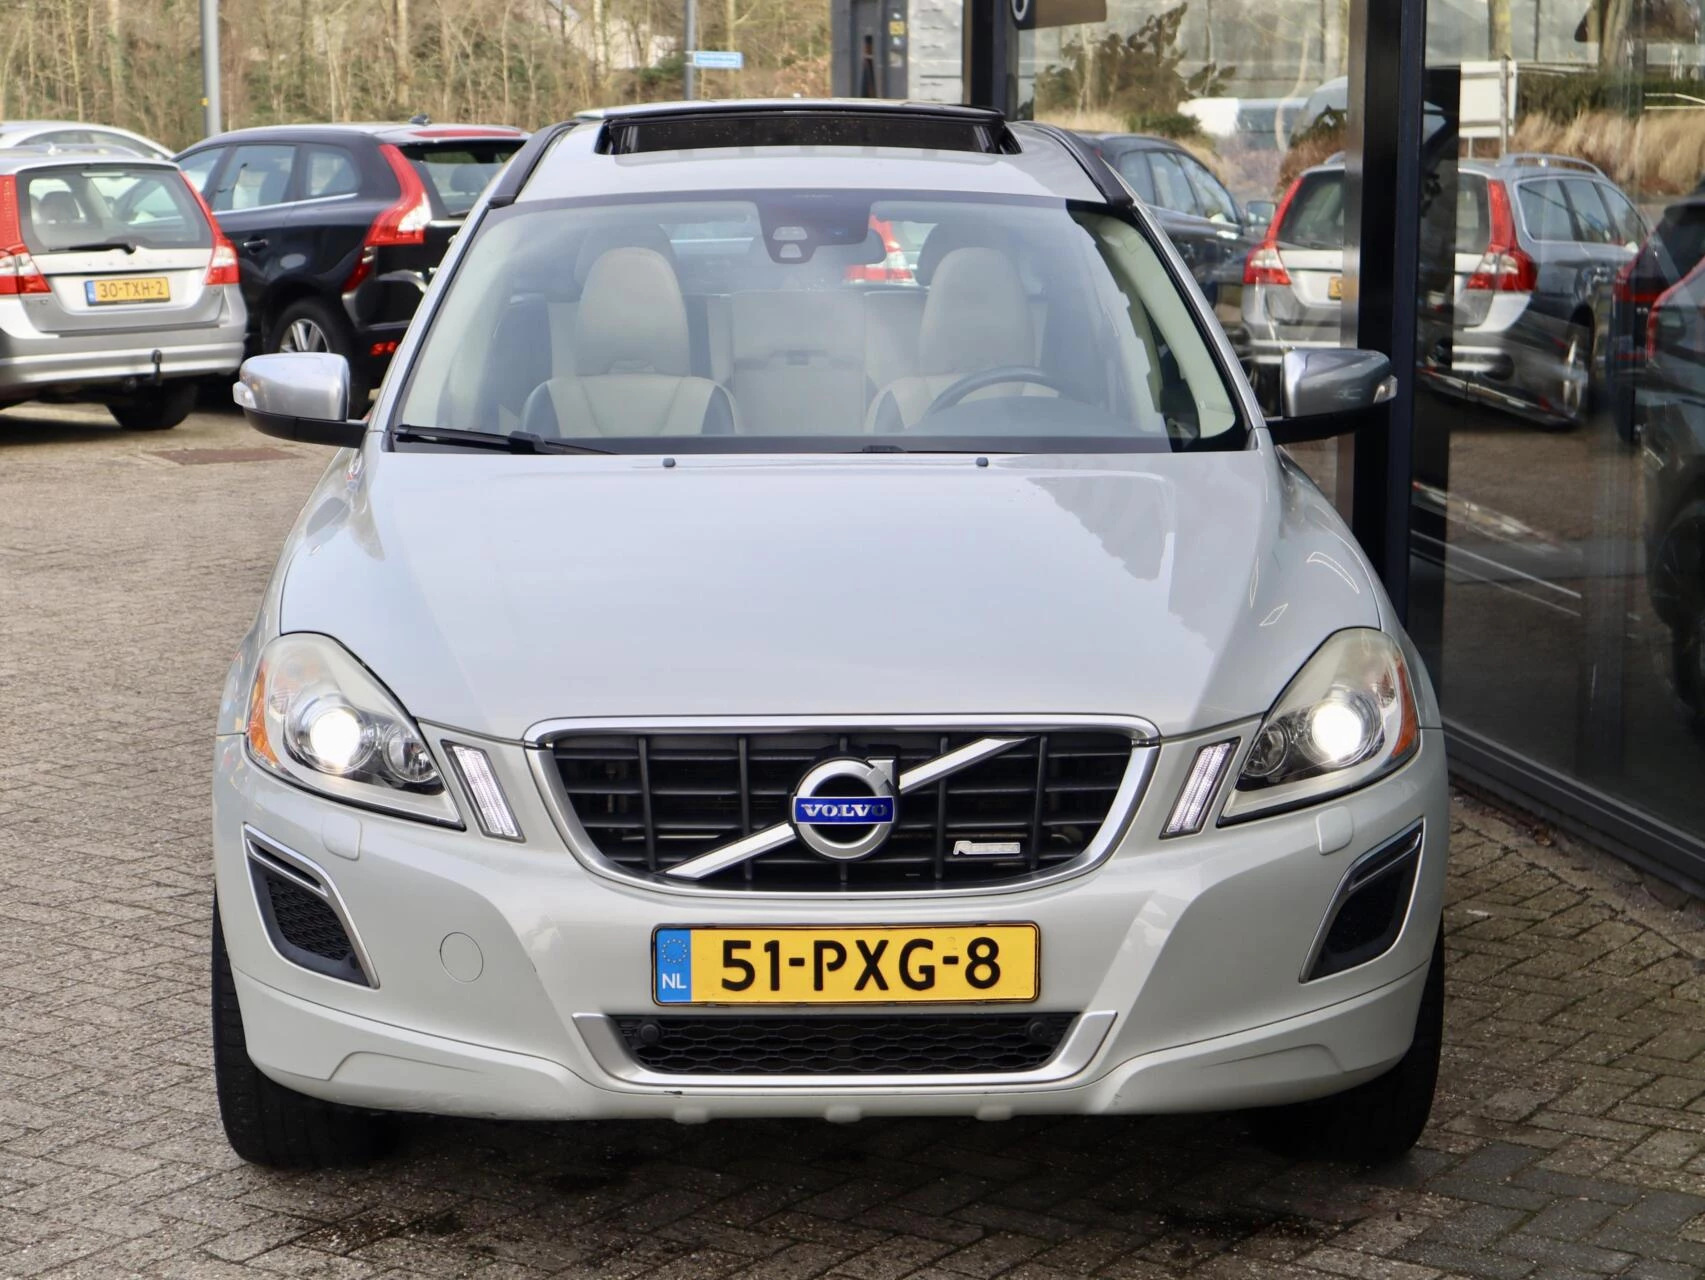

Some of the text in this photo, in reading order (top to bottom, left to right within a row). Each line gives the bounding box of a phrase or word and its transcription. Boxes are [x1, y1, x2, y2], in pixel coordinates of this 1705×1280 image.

[100, 280, 165, 298] 30-TXH-2
[801, 804, 888, 817] VOLVO
[721, 937, 1001, 992] 51-PXG-8
[662, 974, 687, 989] NL
